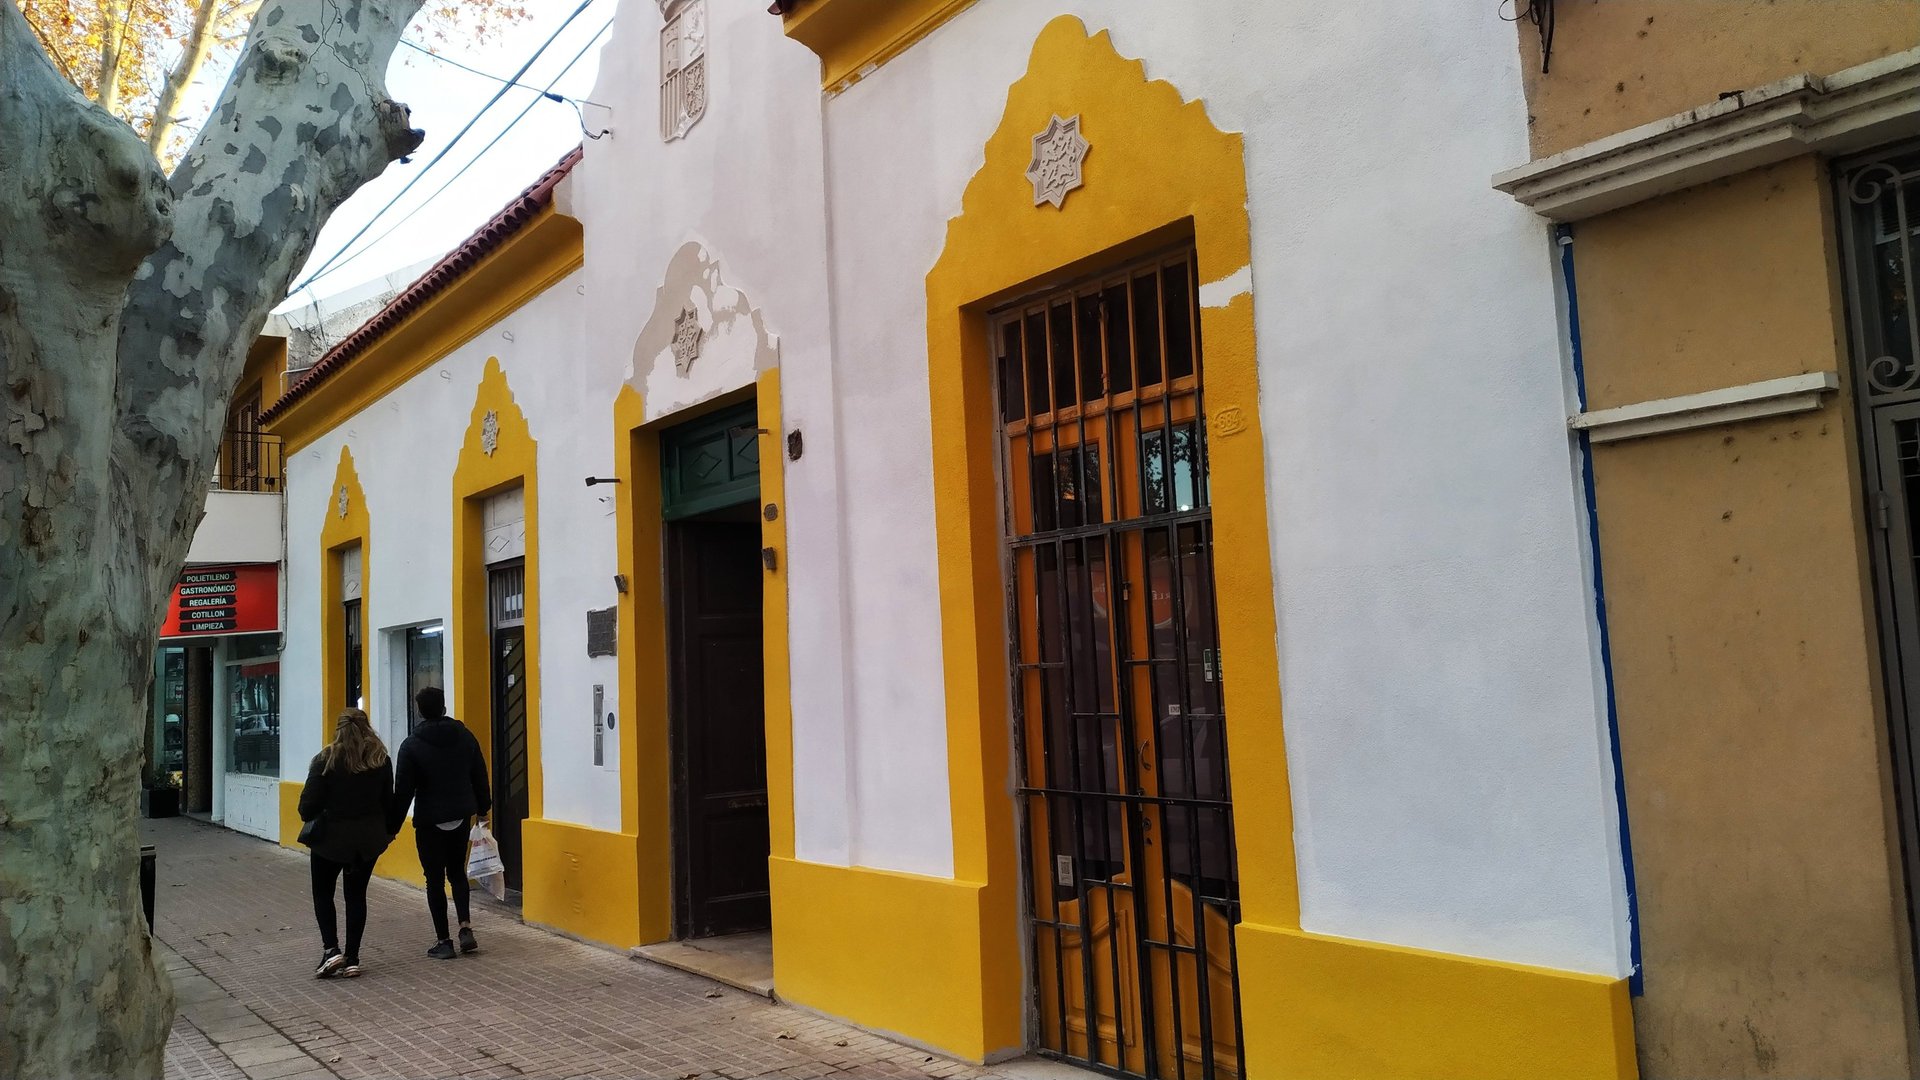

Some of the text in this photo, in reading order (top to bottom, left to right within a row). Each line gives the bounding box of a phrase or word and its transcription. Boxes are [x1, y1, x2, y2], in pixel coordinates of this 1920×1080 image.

[186, 573, 229, 582] POLIETILENO
[181, 584, 235, 594] GASTRONÓMICO
[189, 596, 226, 606] REGALERÍA
[191, 610, 224, 618] COTILLON
[192, 622, 224, 630] LIMPIEZA
